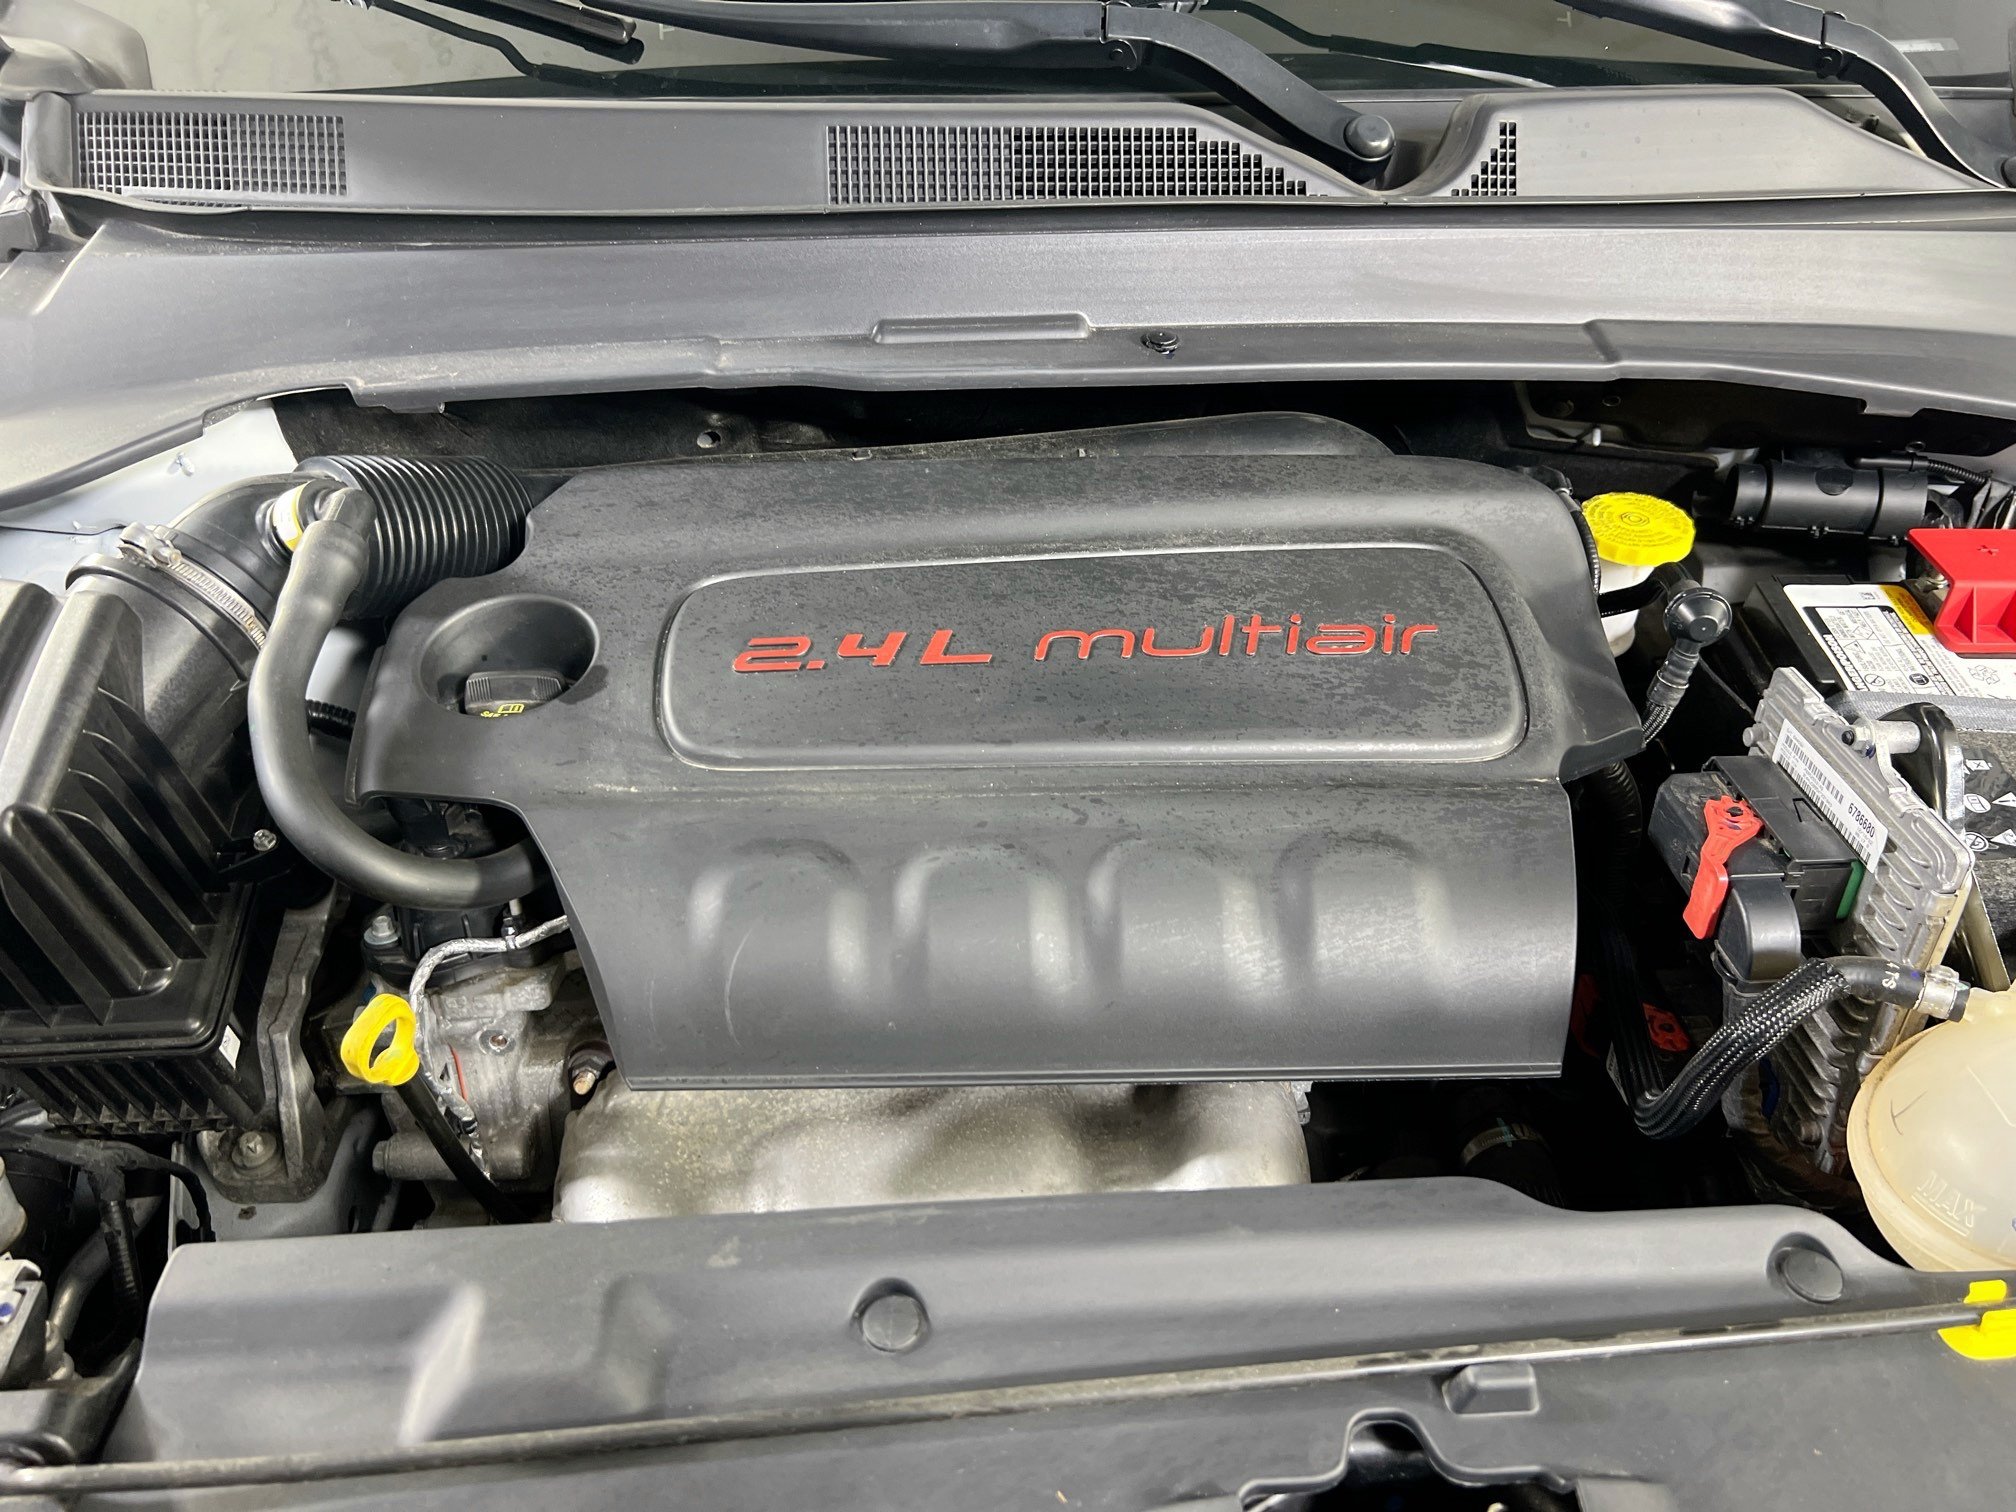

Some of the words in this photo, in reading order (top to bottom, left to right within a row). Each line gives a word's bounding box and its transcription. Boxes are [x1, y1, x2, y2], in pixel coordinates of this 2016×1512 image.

[1034, 614, 1438, 661] multiair
[1848, 803, 1875, 837] 6786680
[1916, 1171, 1982, 1228] MAX
